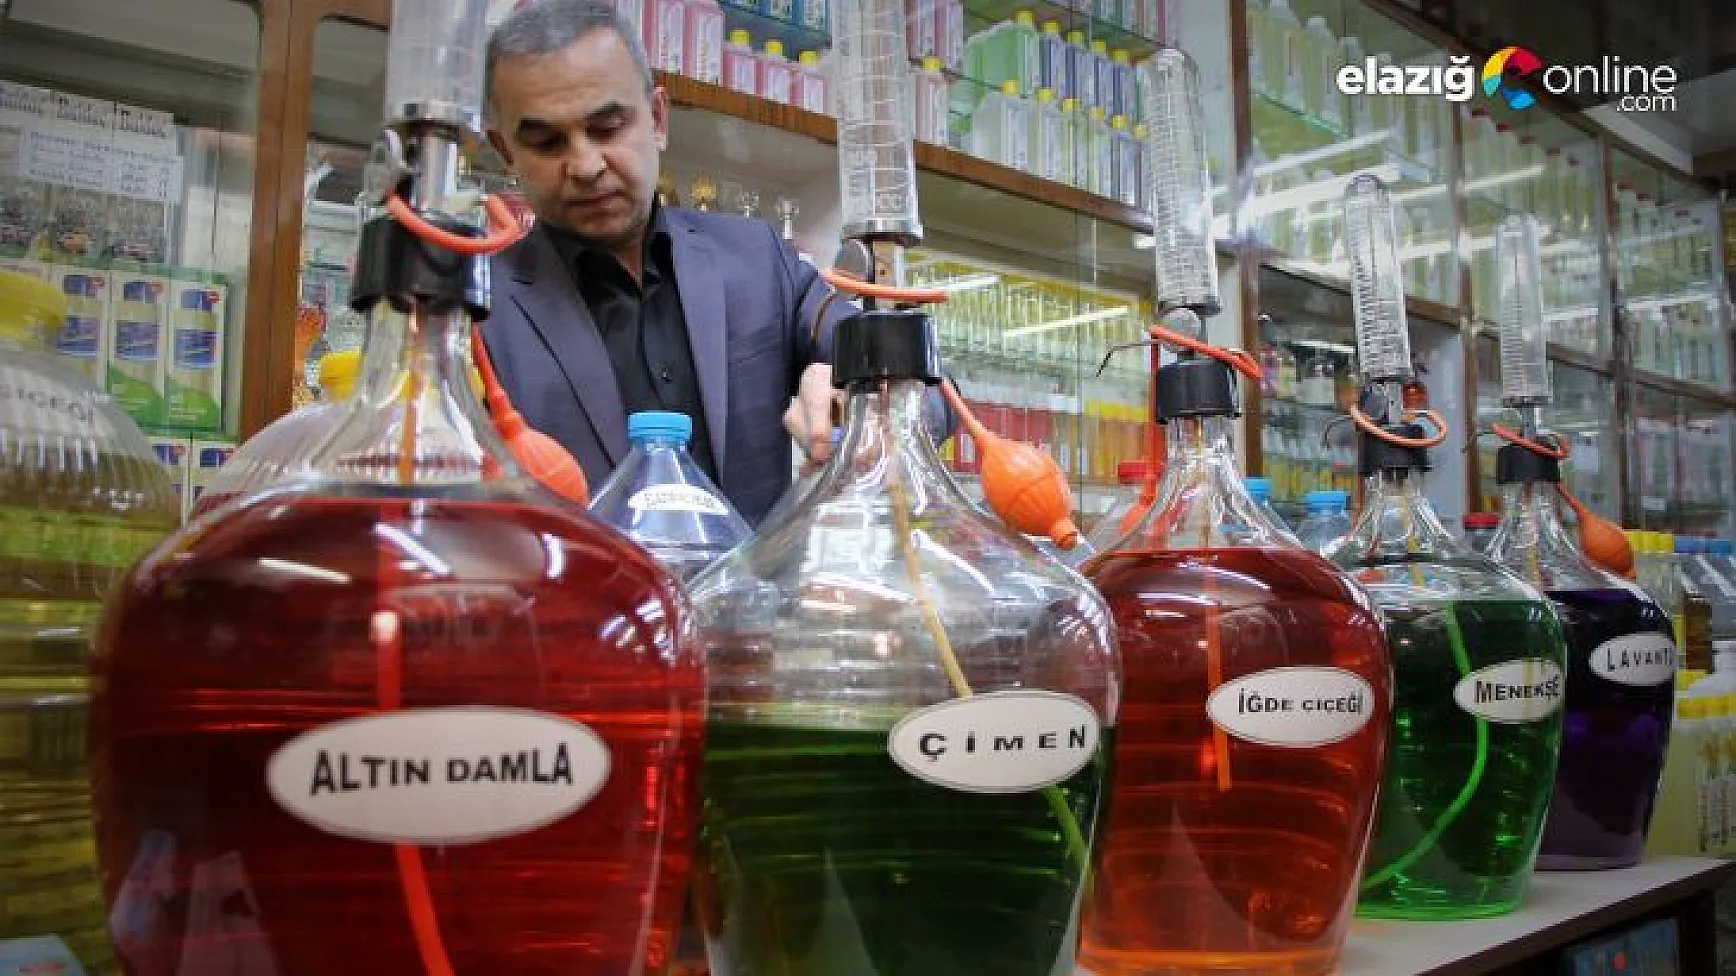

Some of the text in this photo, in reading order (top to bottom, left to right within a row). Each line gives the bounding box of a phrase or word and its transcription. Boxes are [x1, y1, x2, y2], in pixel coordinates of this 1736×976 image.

[919, 723, 1086, 762] ÇİMEN
[309, 741, 574, 796] ALTIN DAMLA
